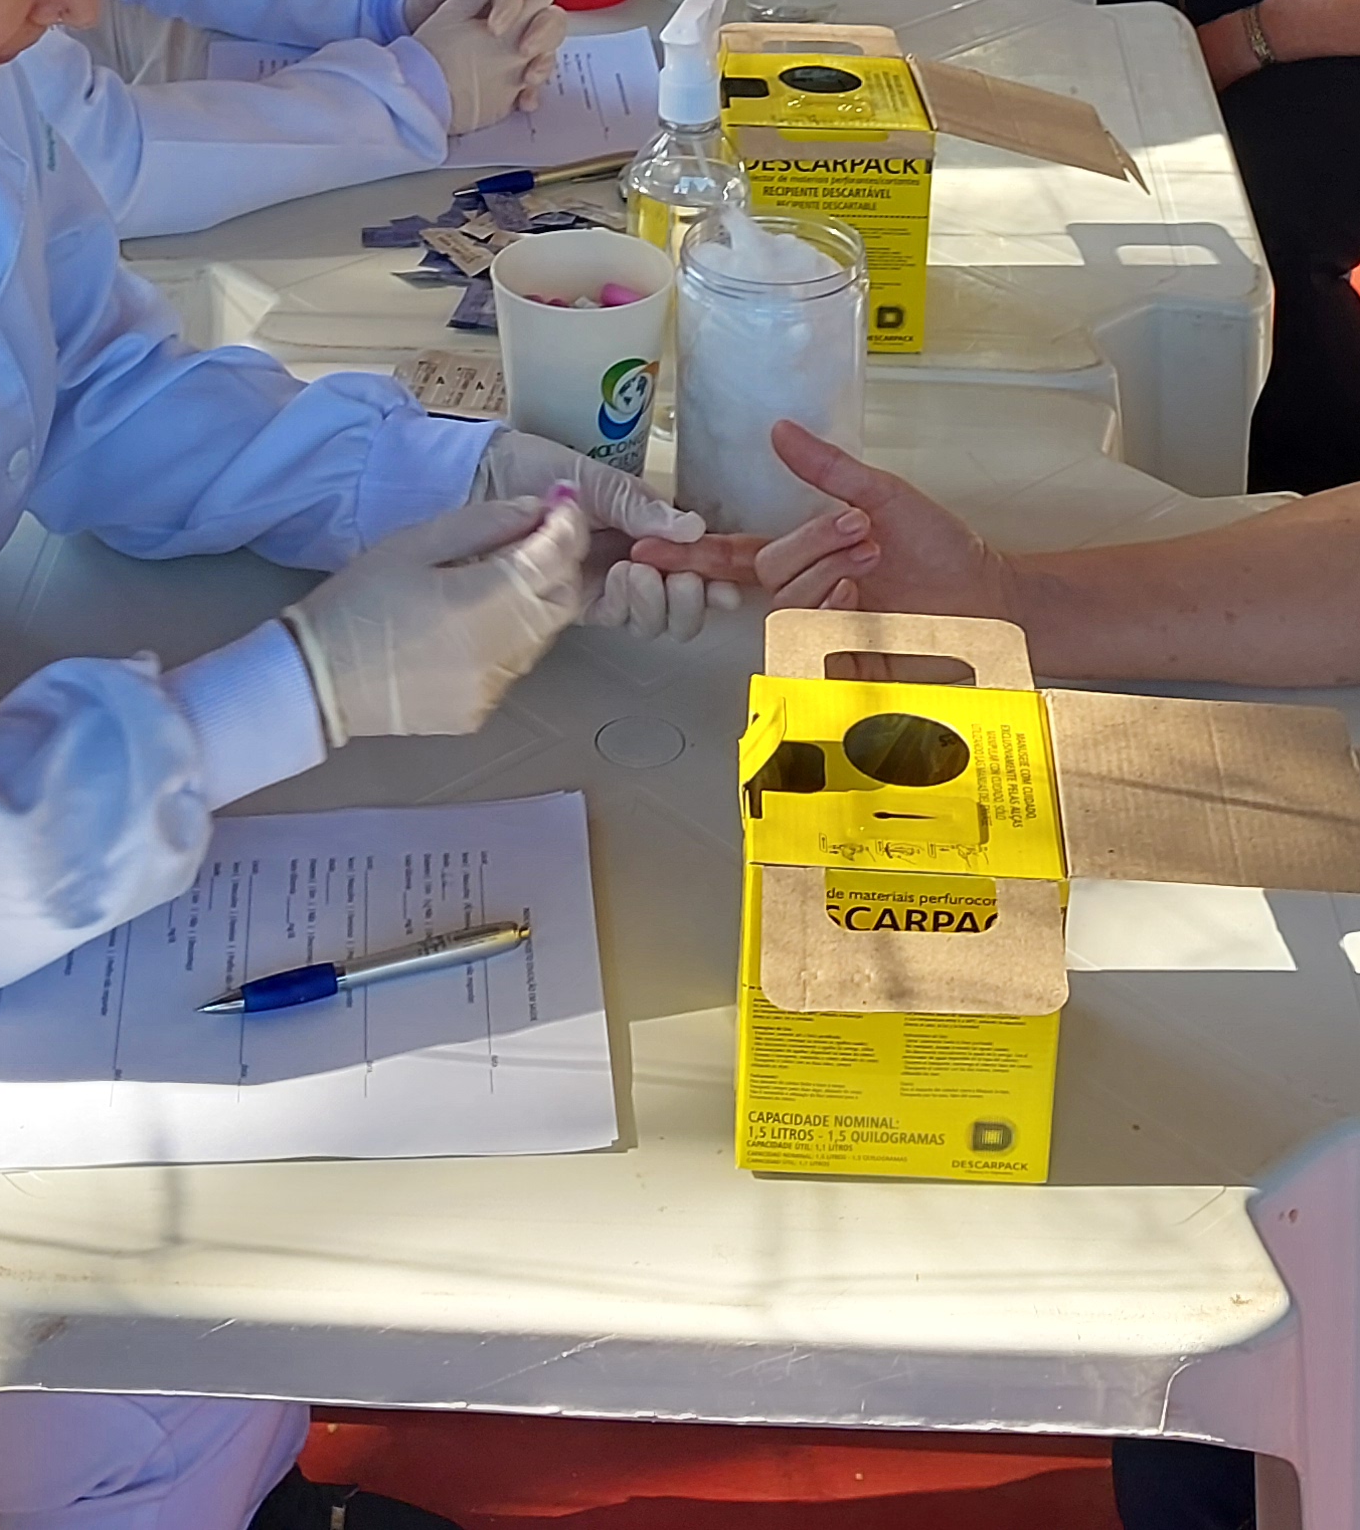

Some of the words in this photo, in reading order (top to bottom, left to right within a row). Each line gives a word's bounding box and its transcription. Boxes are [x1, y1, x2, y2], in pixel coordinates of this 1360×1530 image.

[763, 186, 820, 198] RECIPIENTE
[826, 887, 844, 899] de
[849, 891, 915, 904] materiais
[748, 1111, 830, 1127] CAPACIDADE
[834, 1115, 900, 1130] NOMINAL:
[748, 1126, 766, 1139] 1,5
[771, 1127, 815, 1141] LITROS
[828, 1130, 846, 1143] 1,5
[850, 1131, 945, 1146] QUILOGRAMAS
[952, 1159, 1029, 1171] DESCARPACK
